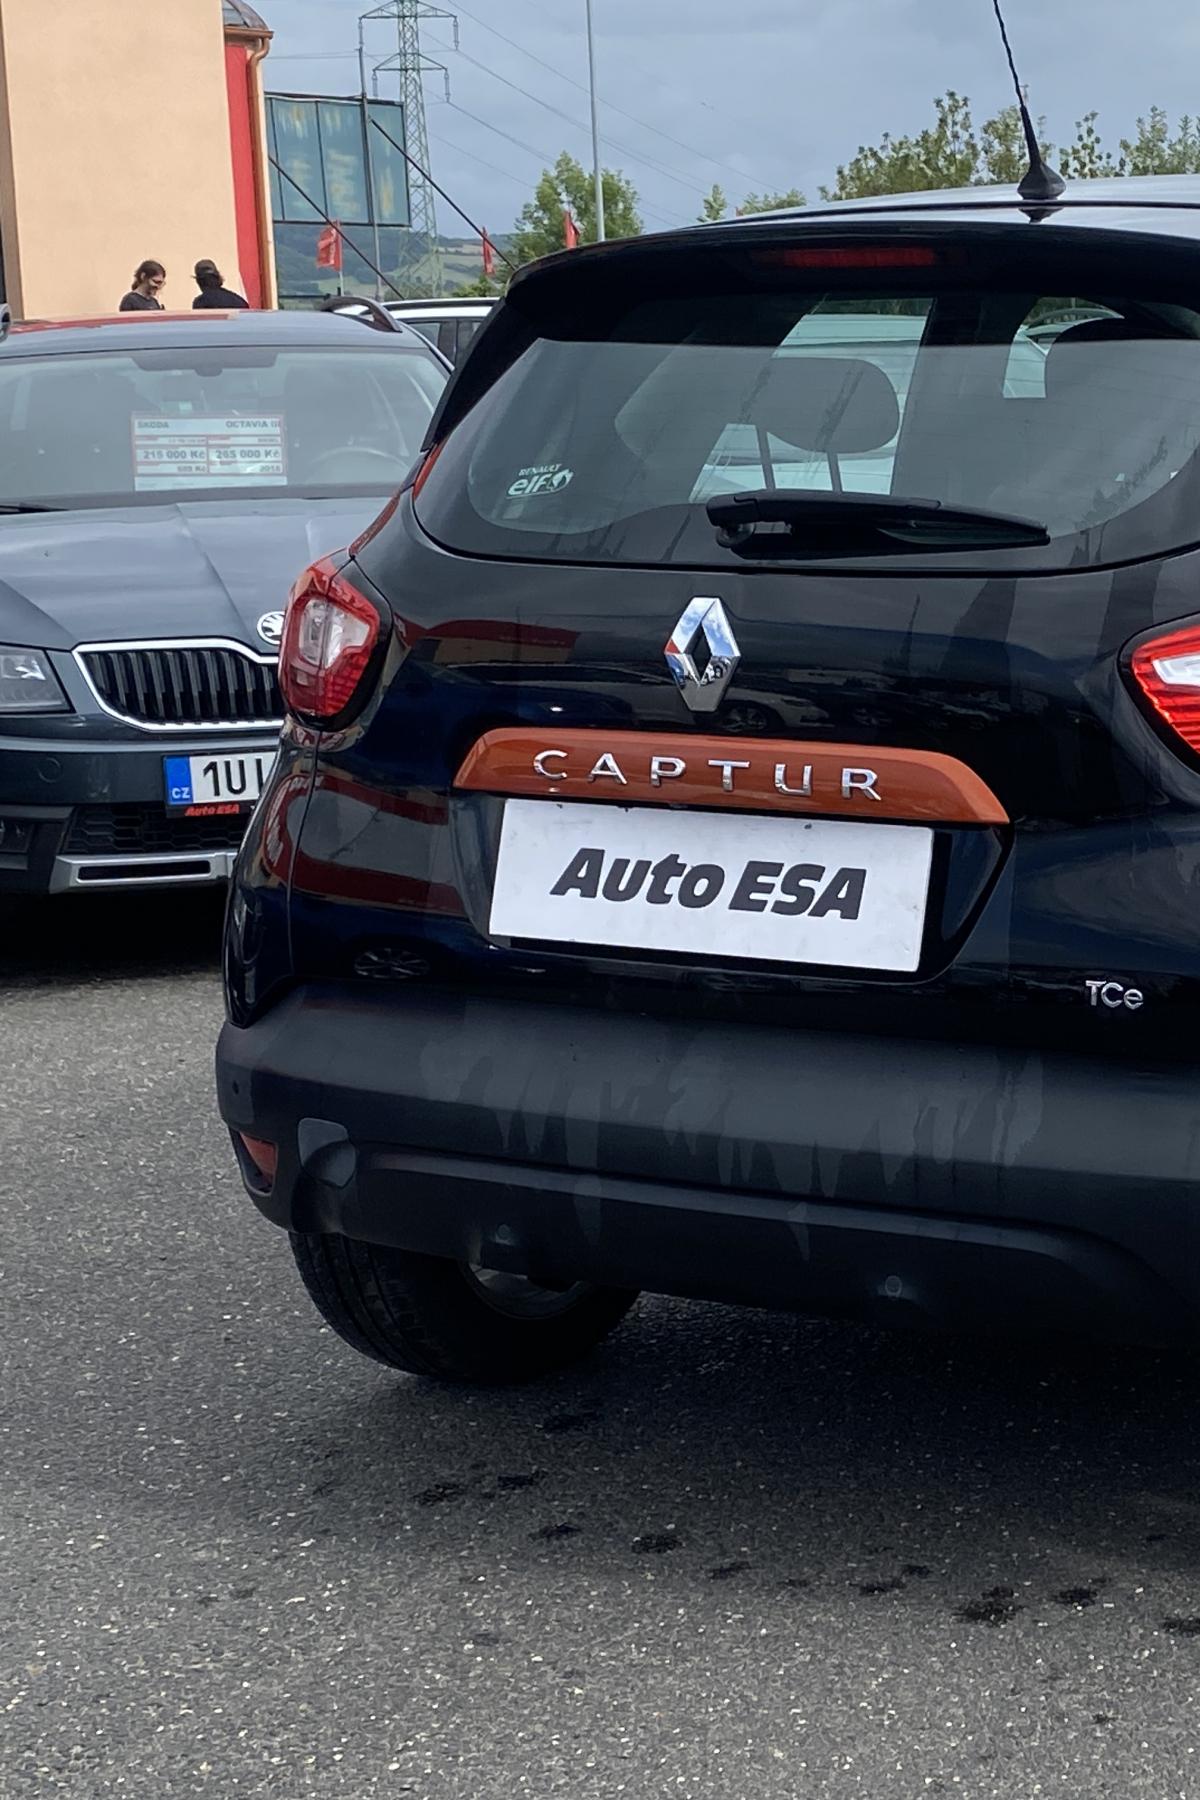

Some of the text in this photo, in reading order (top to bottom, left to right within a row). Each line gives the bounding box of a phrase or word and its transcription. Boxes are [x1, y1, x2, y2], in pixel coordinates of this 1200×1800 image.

[225, 420, 269, 429] OCTAVIA
[533, 749, 882, 801] CAPTUR
[171, 786, 191, 799] CZ
[549, 847, 867, 921] Auto ESA
[1085, 979, 1144, 1010] TCe
